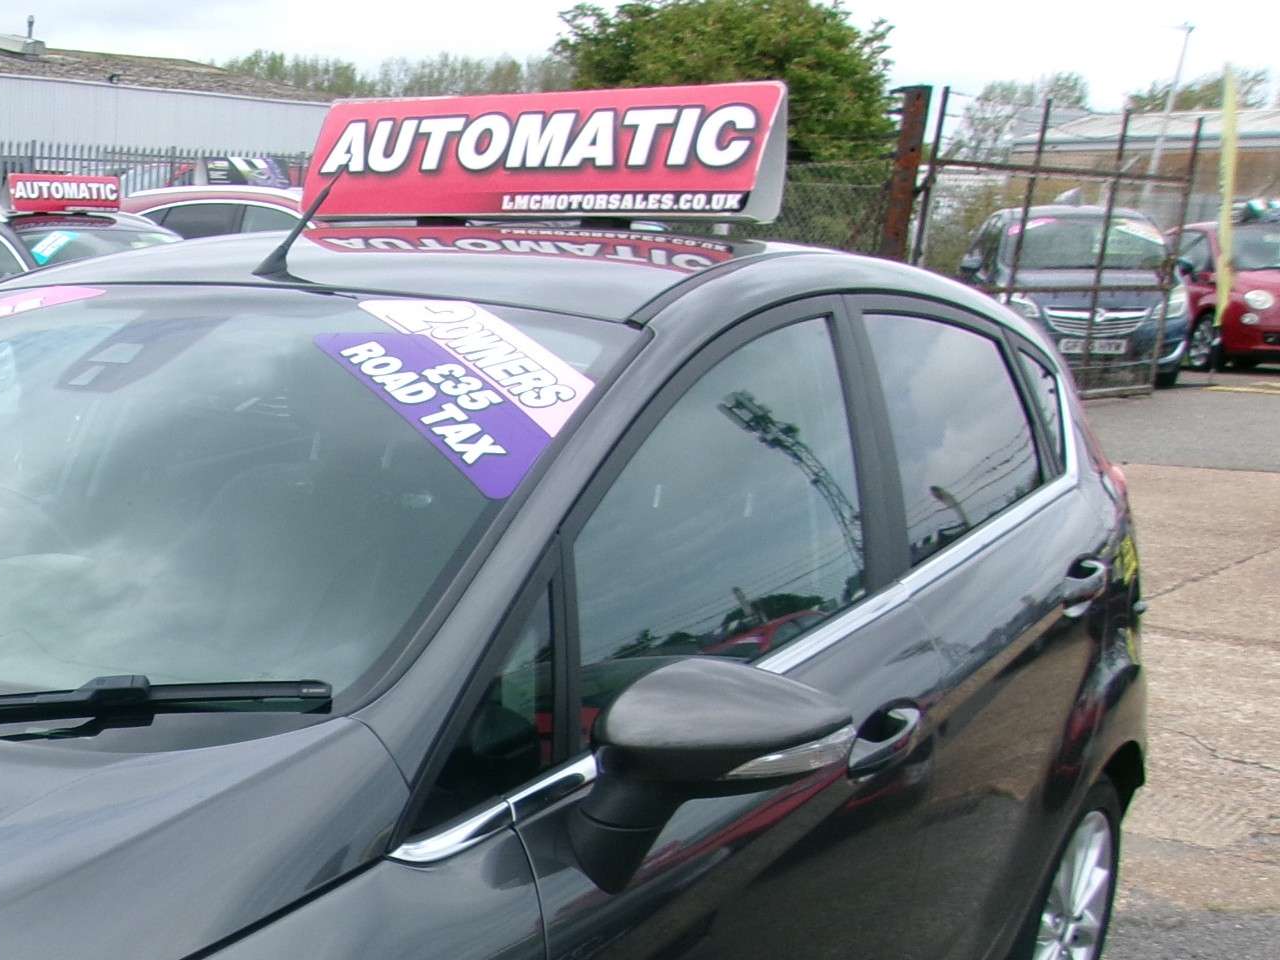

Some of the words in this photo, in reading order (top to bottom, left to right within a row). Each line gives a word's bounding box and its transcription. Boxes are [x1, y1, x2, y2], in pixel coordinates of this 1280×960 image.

[320, 104, 757, 174] AUTOMATIC
[15, 181, 118, 200] AUTOMATIC
[501, 192, 743, 211] LMCMOTORSALES.CO.UK
[421, 363, 504, 411] £35
[430, 321, 577, 408] OWNERS
[339, 341, 437, 404] ROAD
[419, 402, 508, 465] TAX
